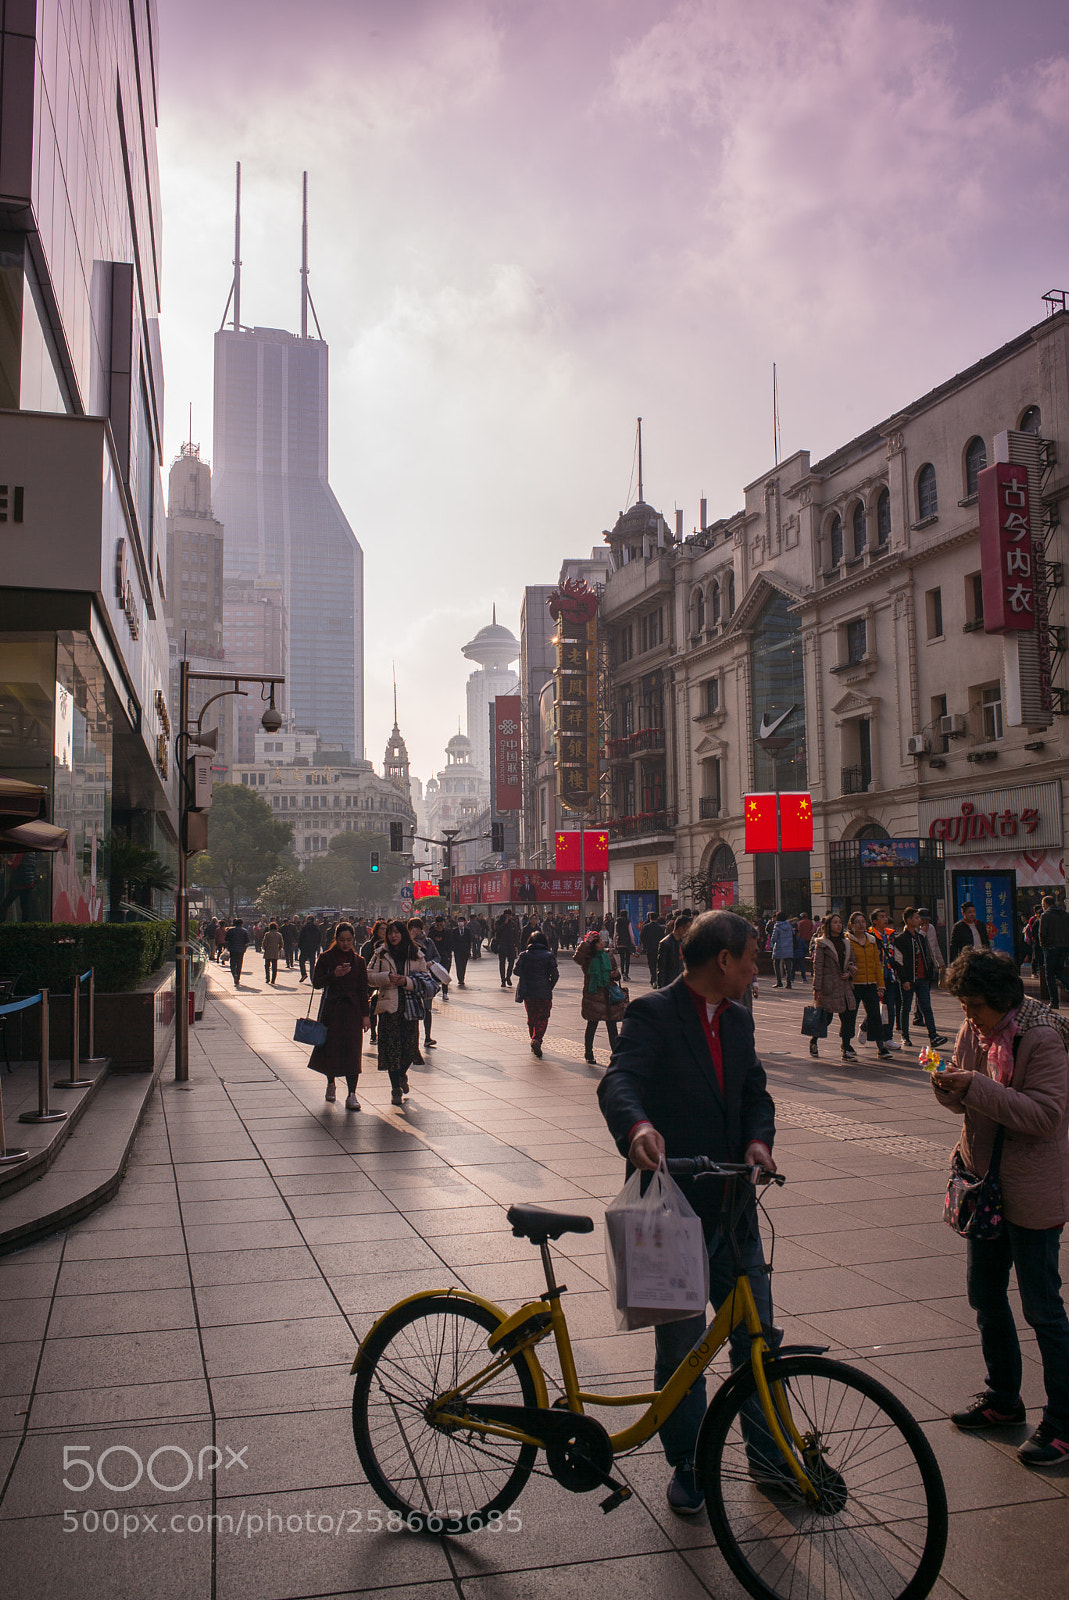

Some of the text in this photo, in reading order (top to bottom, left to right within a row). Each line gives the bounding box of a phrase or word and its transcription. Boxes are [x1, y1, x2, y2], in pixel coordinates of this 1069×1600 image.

[1001, 478, 1033, 613] 古今内衣
[1037, 595, 1053, 711] UNDERWEAR
[506, 739, 518, 786] 中国联通
[998, 807, 1041, 836] 古今
